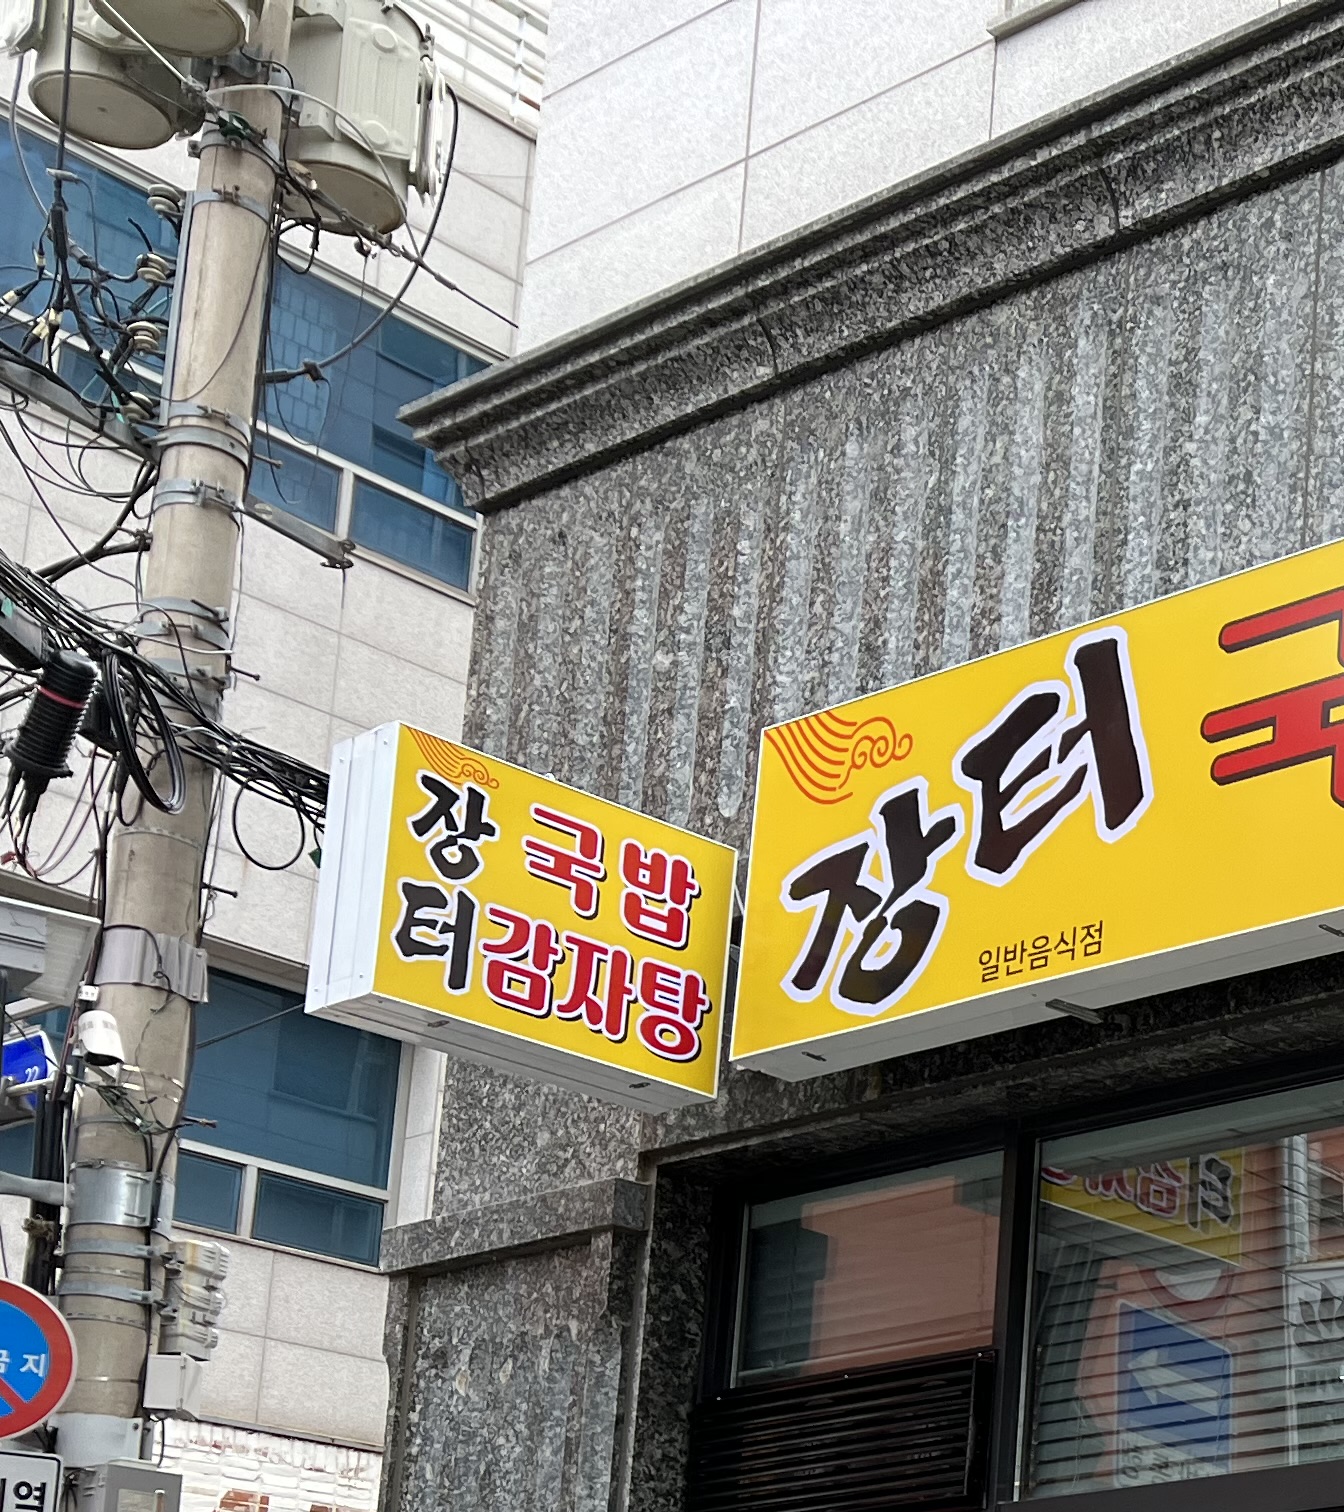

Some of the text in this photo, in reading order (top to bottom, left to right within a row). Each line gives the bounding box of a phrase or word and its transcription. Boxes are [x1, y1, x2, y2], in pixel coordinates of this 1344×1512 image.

[393, 771, 499, 995] 장터
[522, 802, 703, 949] 국밥
[783, 628, 1152, 1014] 장터
[481, 905, 712, 1064] 감자탕
[978, 920, 1106, 983] 일반음식점
